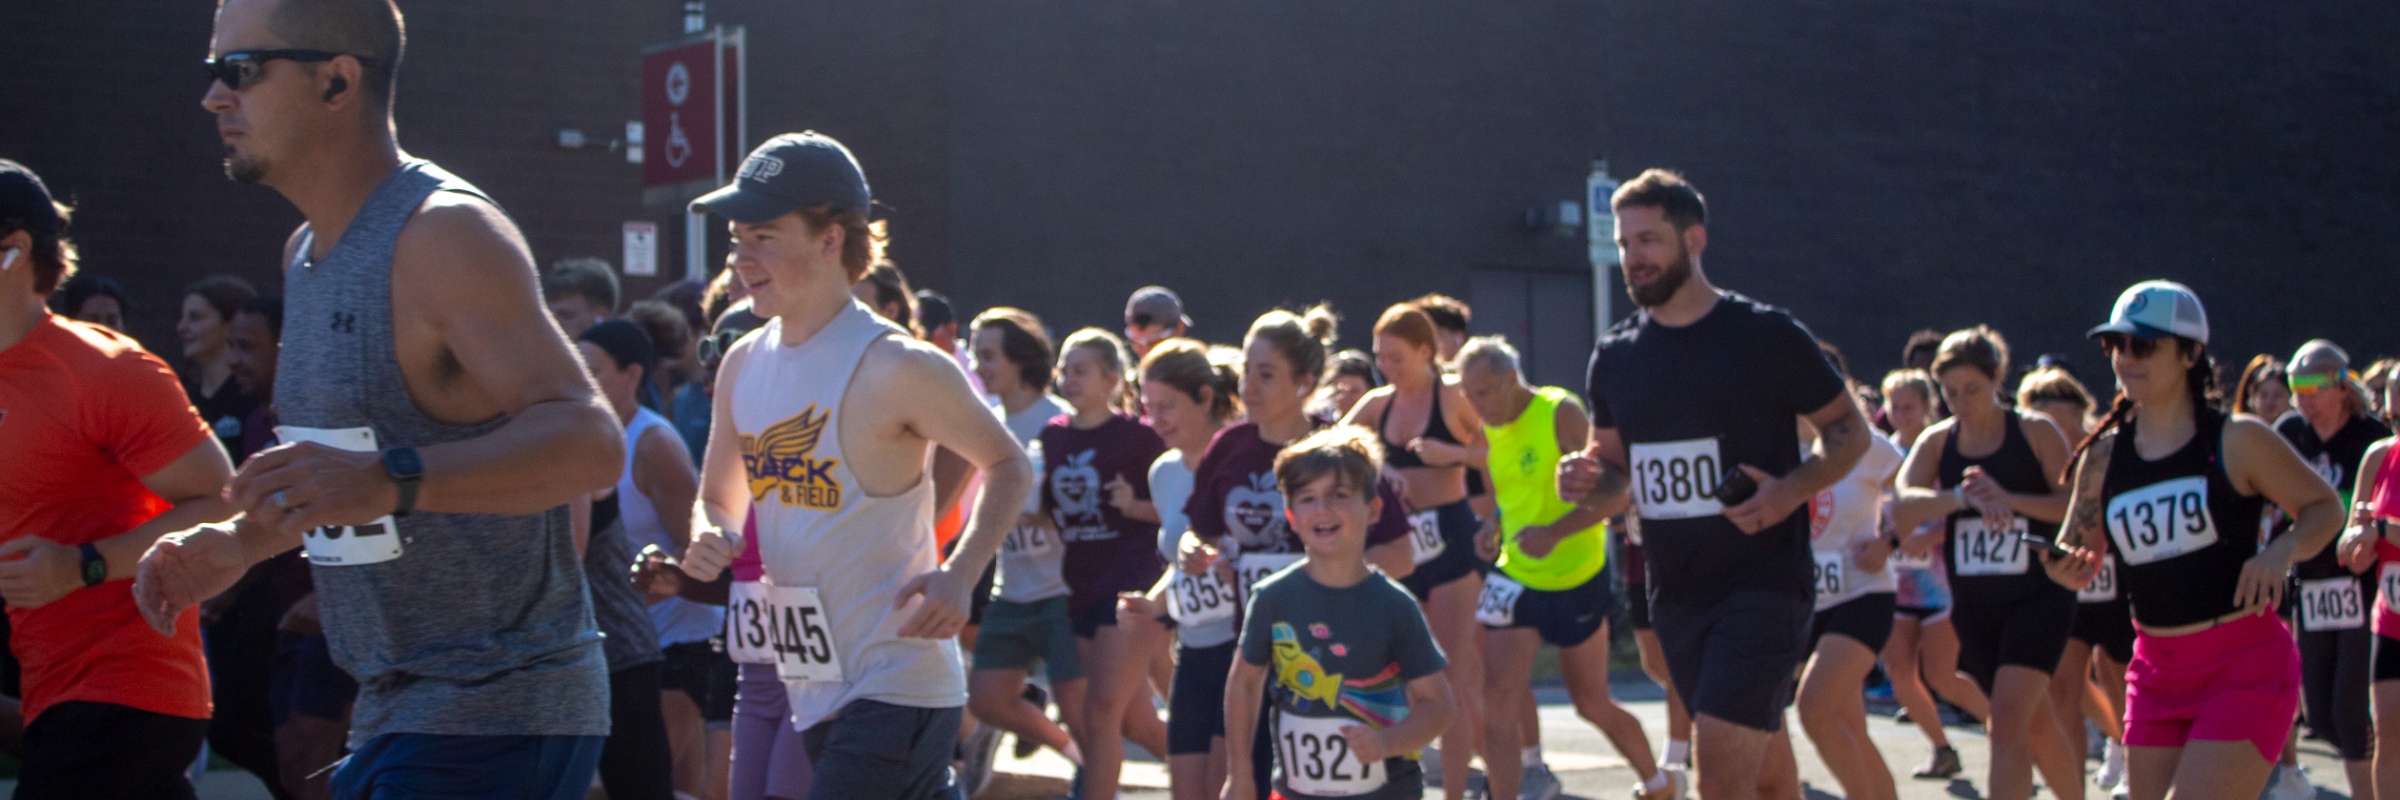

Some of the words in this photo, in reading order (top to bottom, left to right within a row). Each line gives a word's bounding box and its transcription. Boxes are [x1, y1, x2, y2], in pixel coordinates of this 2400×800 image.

[796, 485, 839, 508] FIELD
[1635, 454, 1717, 505] 1380
[2113, 490, 2207, 551] 1379
[1959, 529, 2023, 564] 1427
[2307, 589, 2359, 621] 1403
